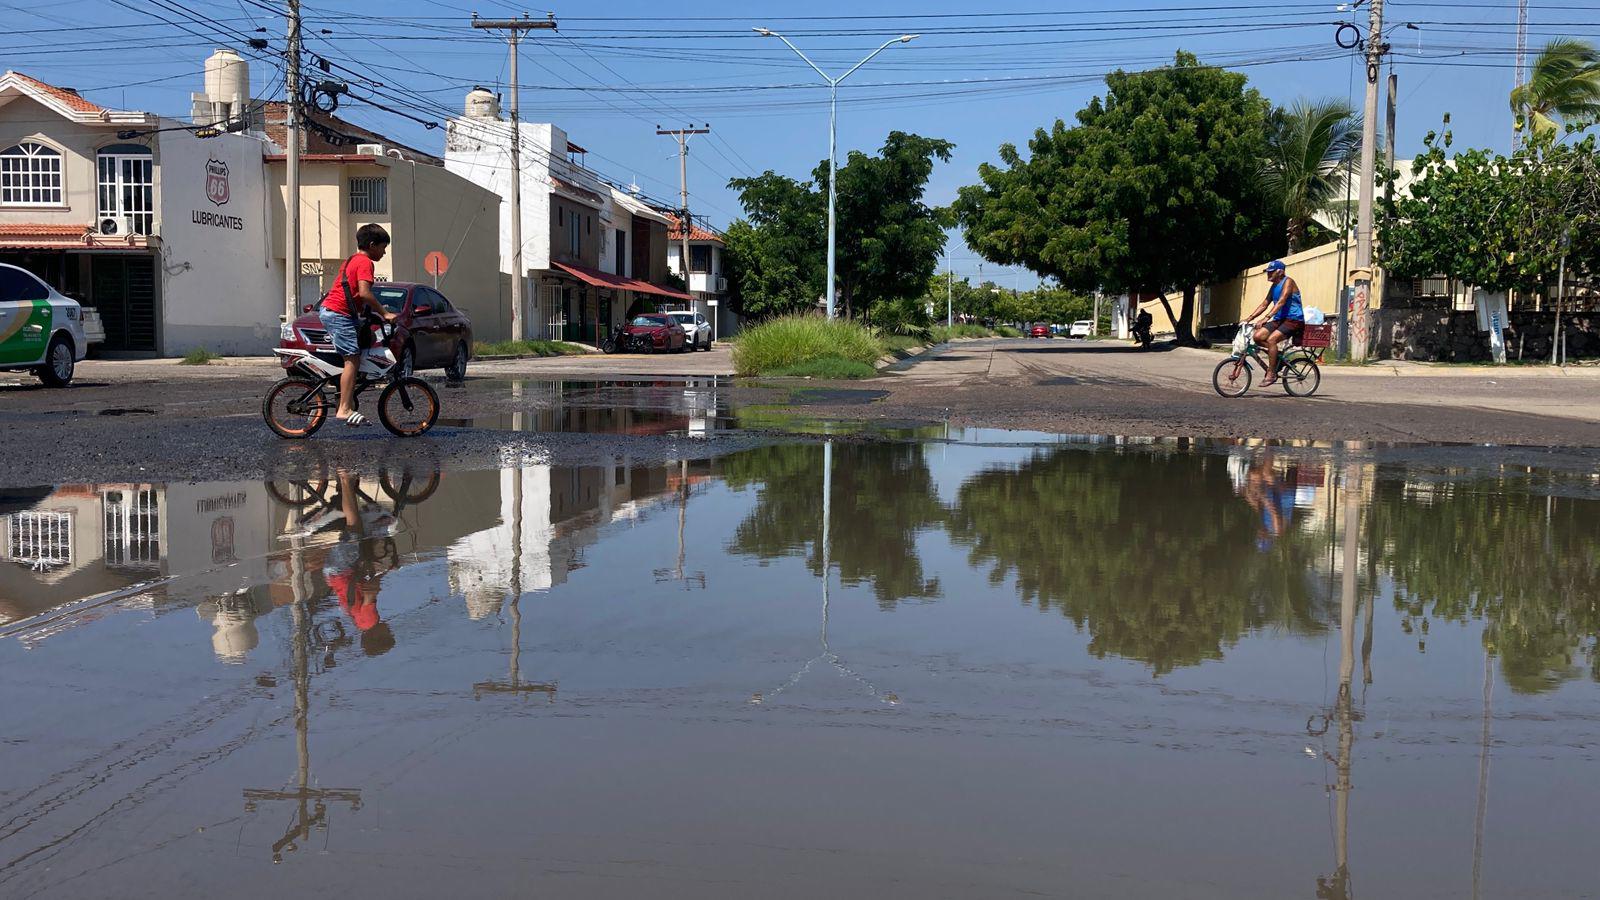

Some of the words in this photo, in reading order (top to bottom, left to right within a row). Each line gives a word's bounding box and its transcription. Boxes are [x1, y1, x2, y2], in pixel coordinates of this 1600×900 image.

[209, 165, 226, 176] PHILLIPS
[210, 178, 225, 196] 66
[192, 210, 242, 230] LUBRICANTES
